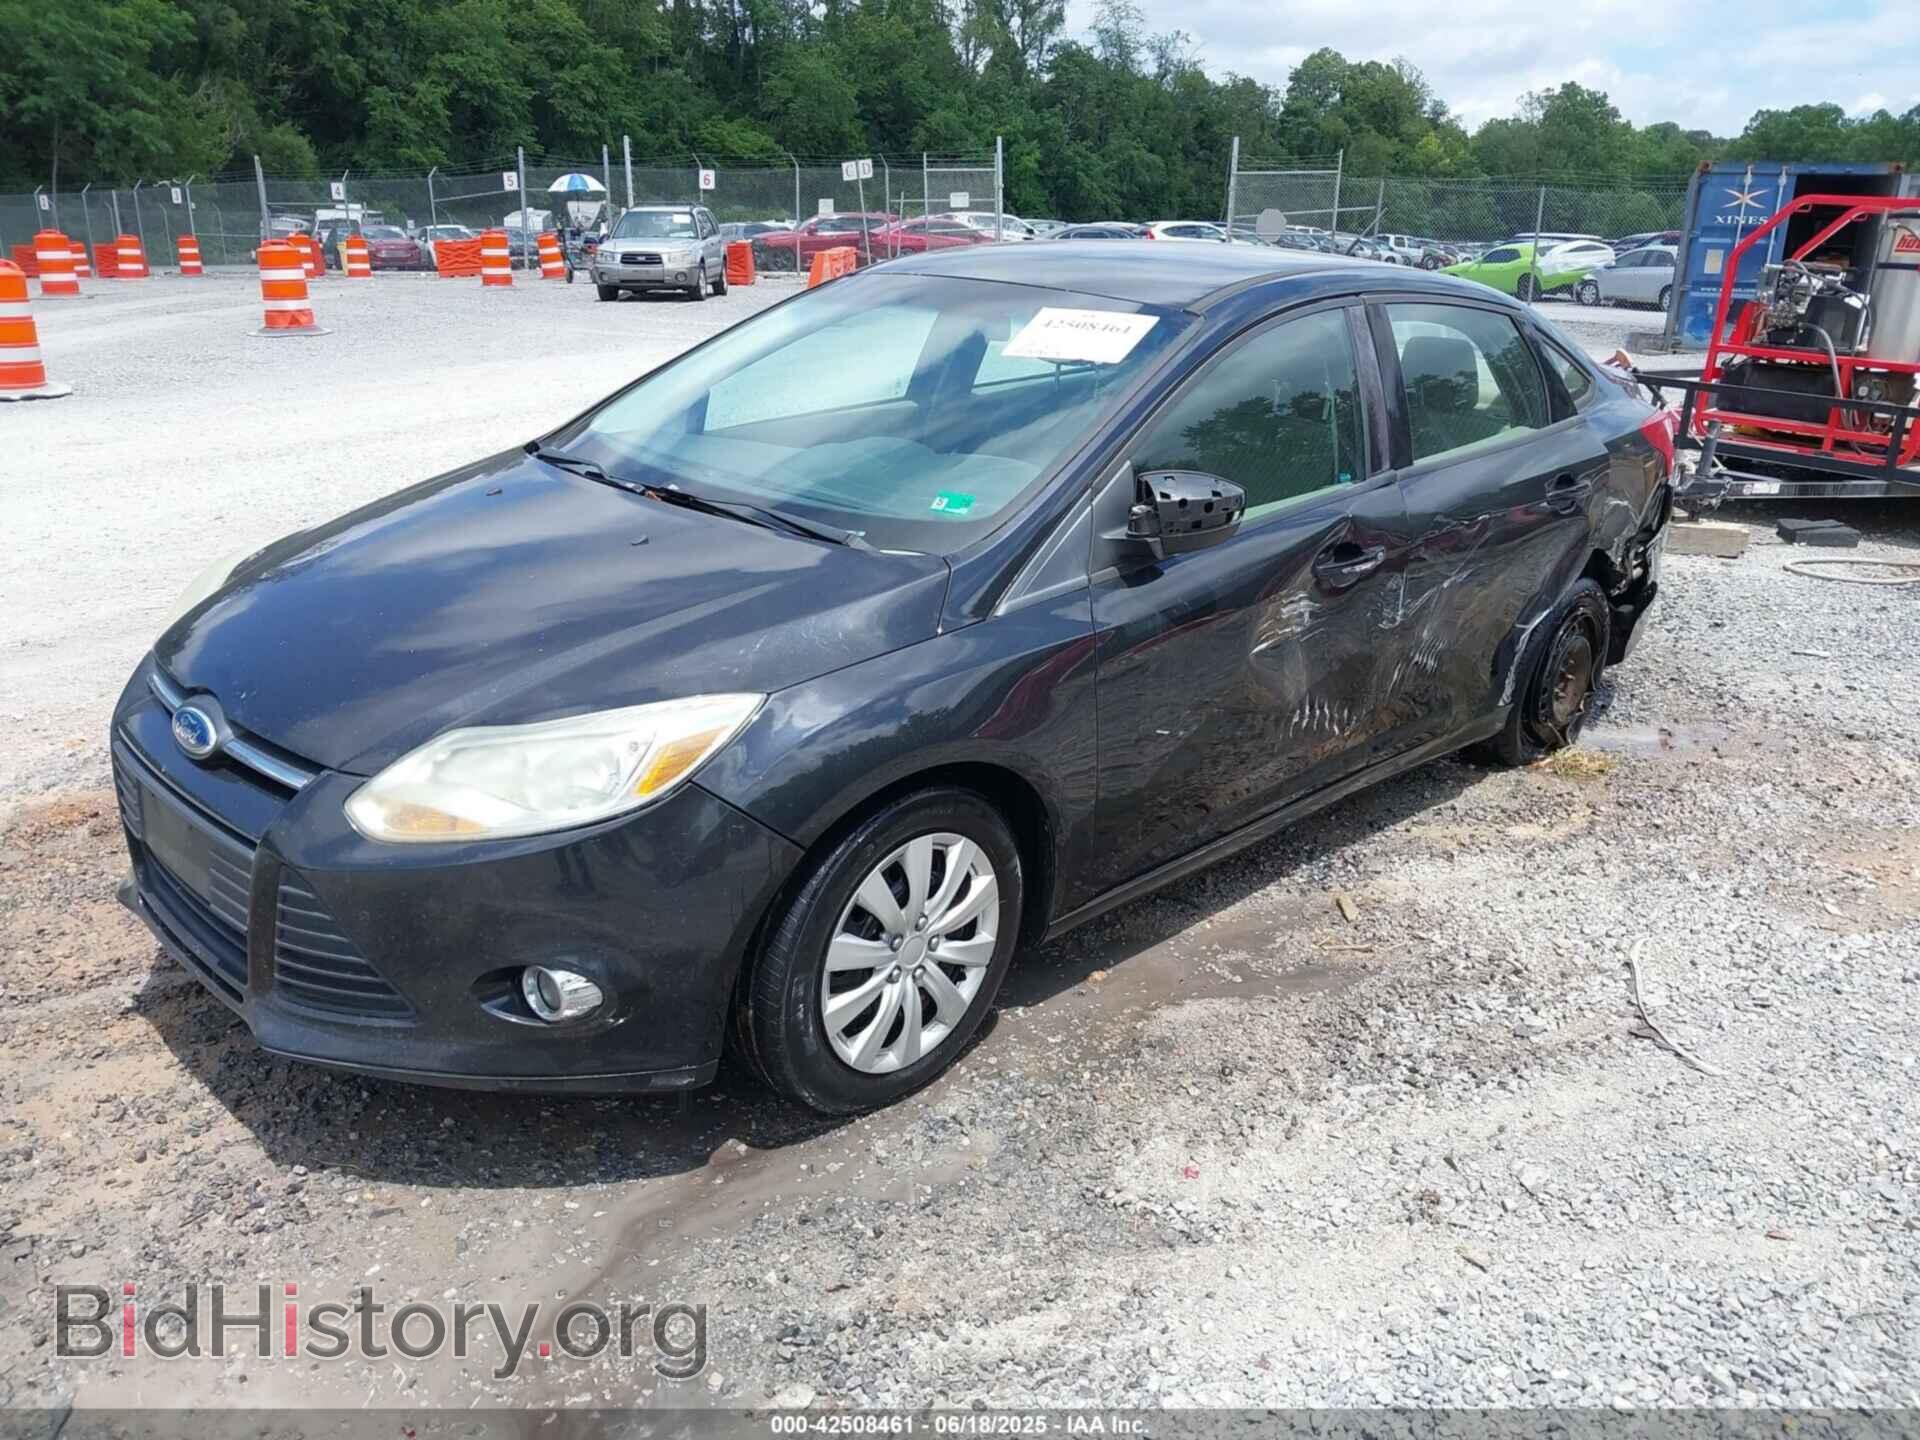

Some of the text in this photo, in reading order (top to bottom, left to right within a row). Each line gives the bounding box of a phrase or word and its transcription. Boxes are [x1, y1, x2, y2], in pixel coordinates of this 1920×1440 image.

[862, 162, 872, 176] D
[506, 175, 514, 187] 5
[703, 173, 712, 186] 6
[176, 713, 202, 745] Ford
